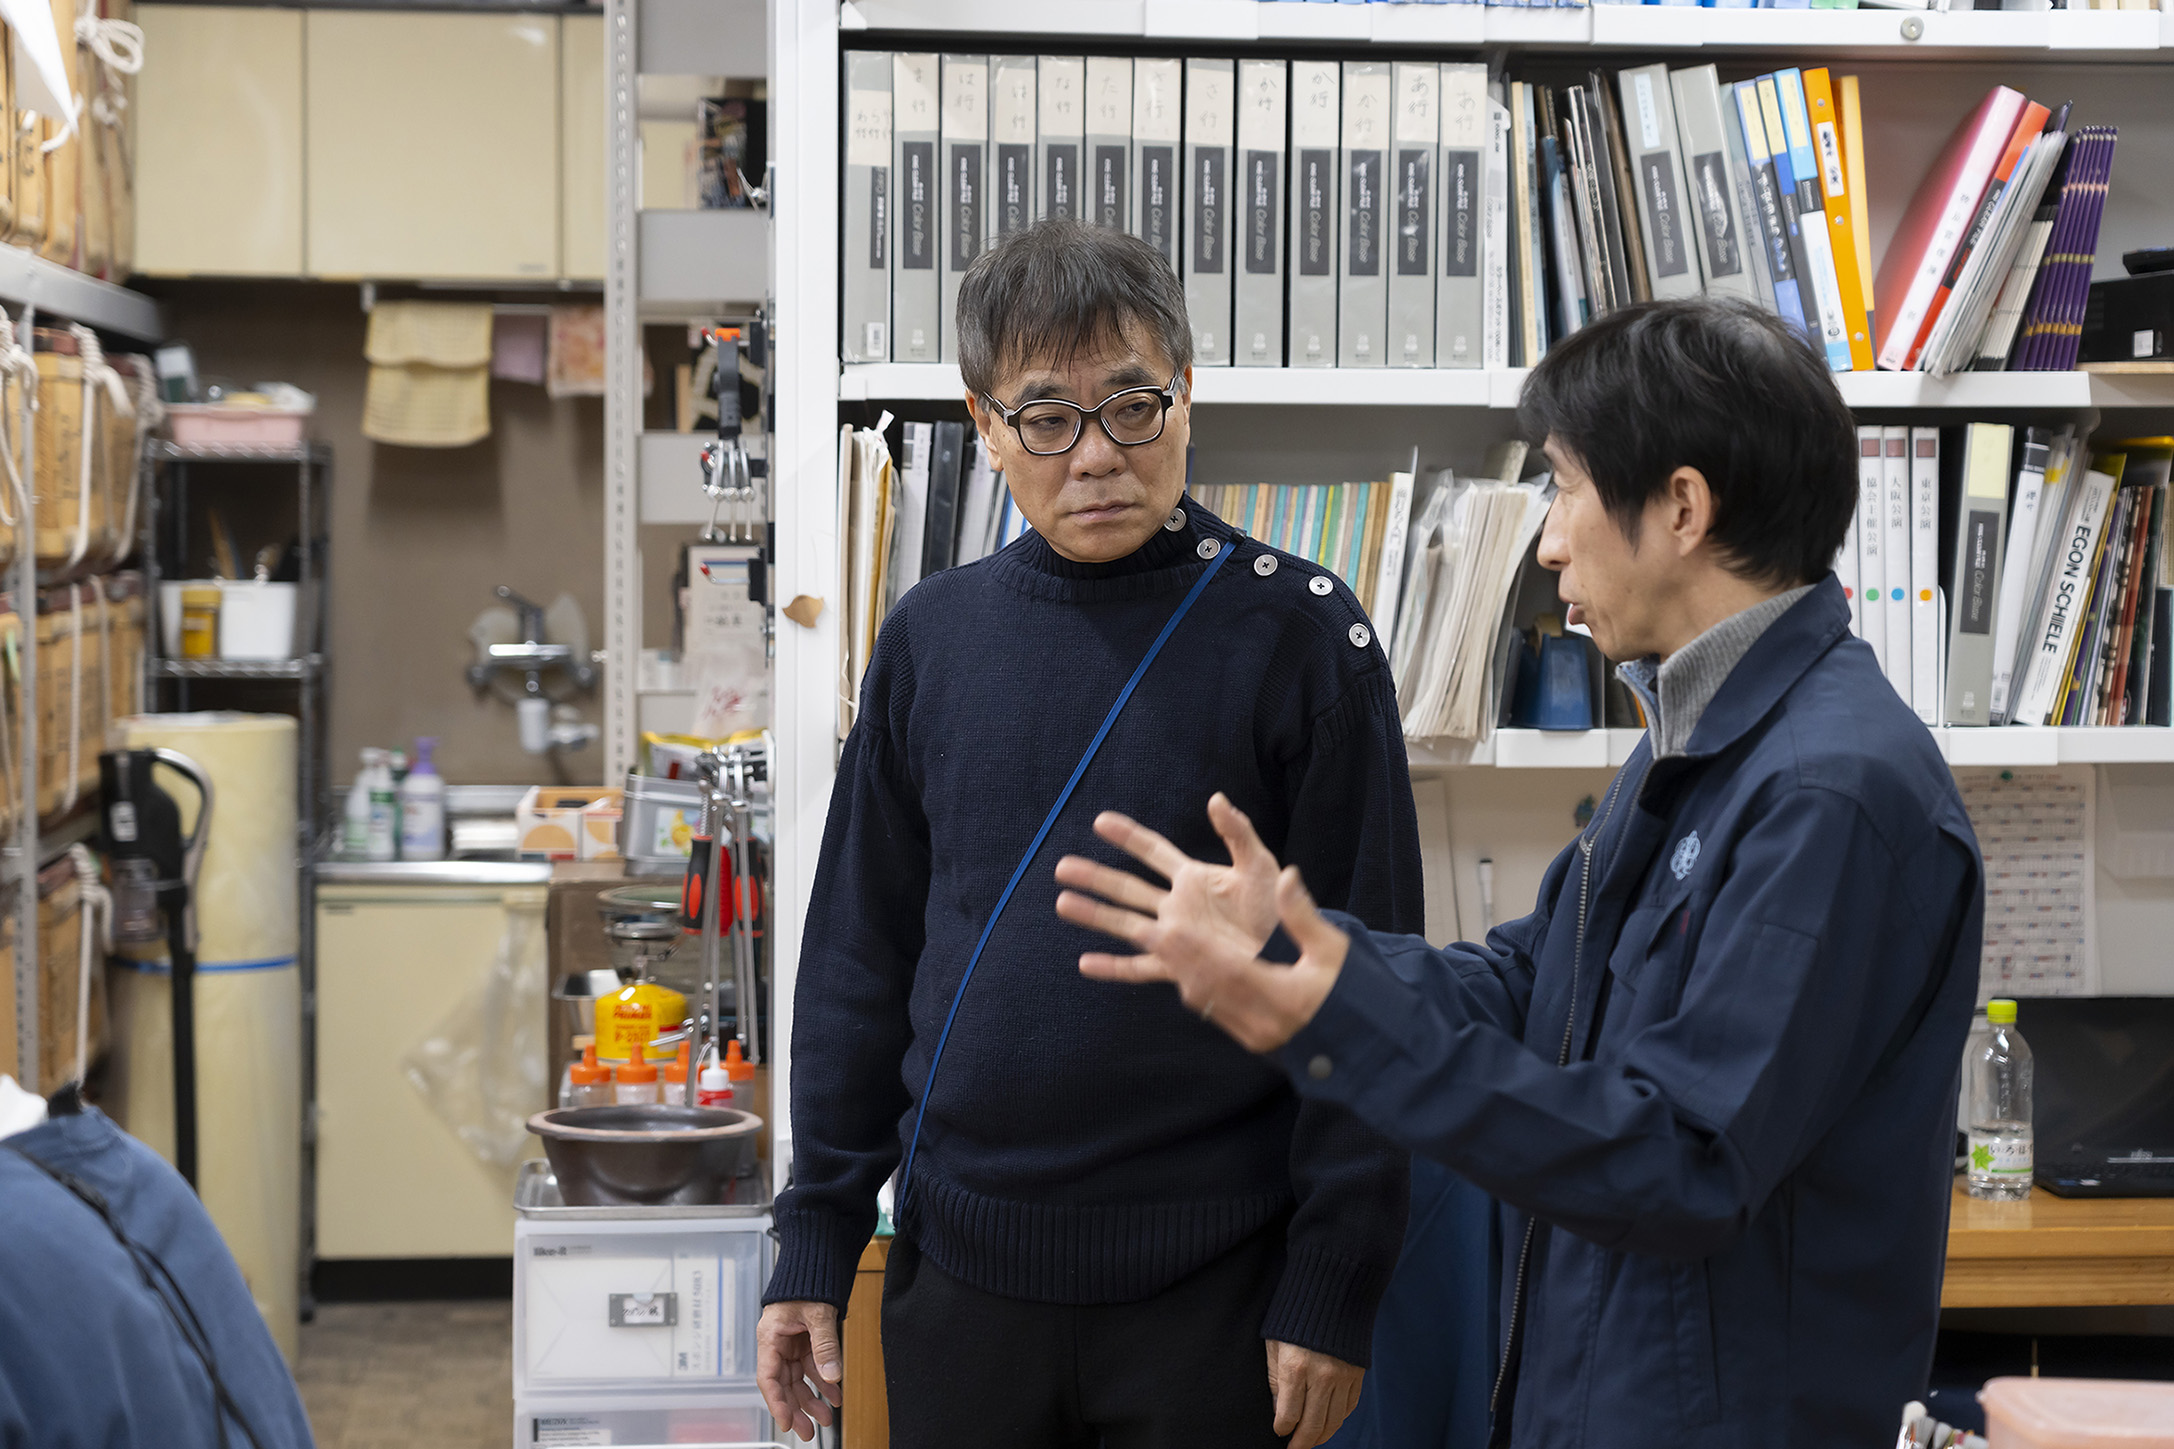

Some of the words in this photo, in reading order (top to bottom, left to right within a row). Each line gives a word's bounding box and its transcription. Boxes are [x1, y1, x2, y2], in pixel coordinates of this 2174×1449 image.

[1258, 77, 1277, 111] か行
[1310, 71, 1335, 108] か行
[1408, 74, 1429, 117] あ行
[1455, 90, 1477, 130] あ行
[1203, 207, 1215, 234] Color
[1256, 208, 1268, 235] Color
[1310, 210, 1321, 237] Color
[1359, 210, 1370, 237] Color
[1457, 211, 1468, 238] Color
[1977, 200, 1996, 228] CLEAR
[1203, 235, 1215, 260] Base
[1256, 235, 1268, 261] Base
[1310, 237, 1321, 263] Base
[1359, 237, 1370, 263] Base
[1408, 237, 1419, 262] Base
[1968, 227, 1982, 247] FILE
[1457, 238, 1468, 264] Base
[1890, 476, 1902, 529] 大阪公演
[1919, 477, 1932, 529] 東京公演
[2064, 525, 2091, 579] EGON
[2042, 579, 2075, 653] SCHIELE
[678, 1352, 688, 1370] 3M
